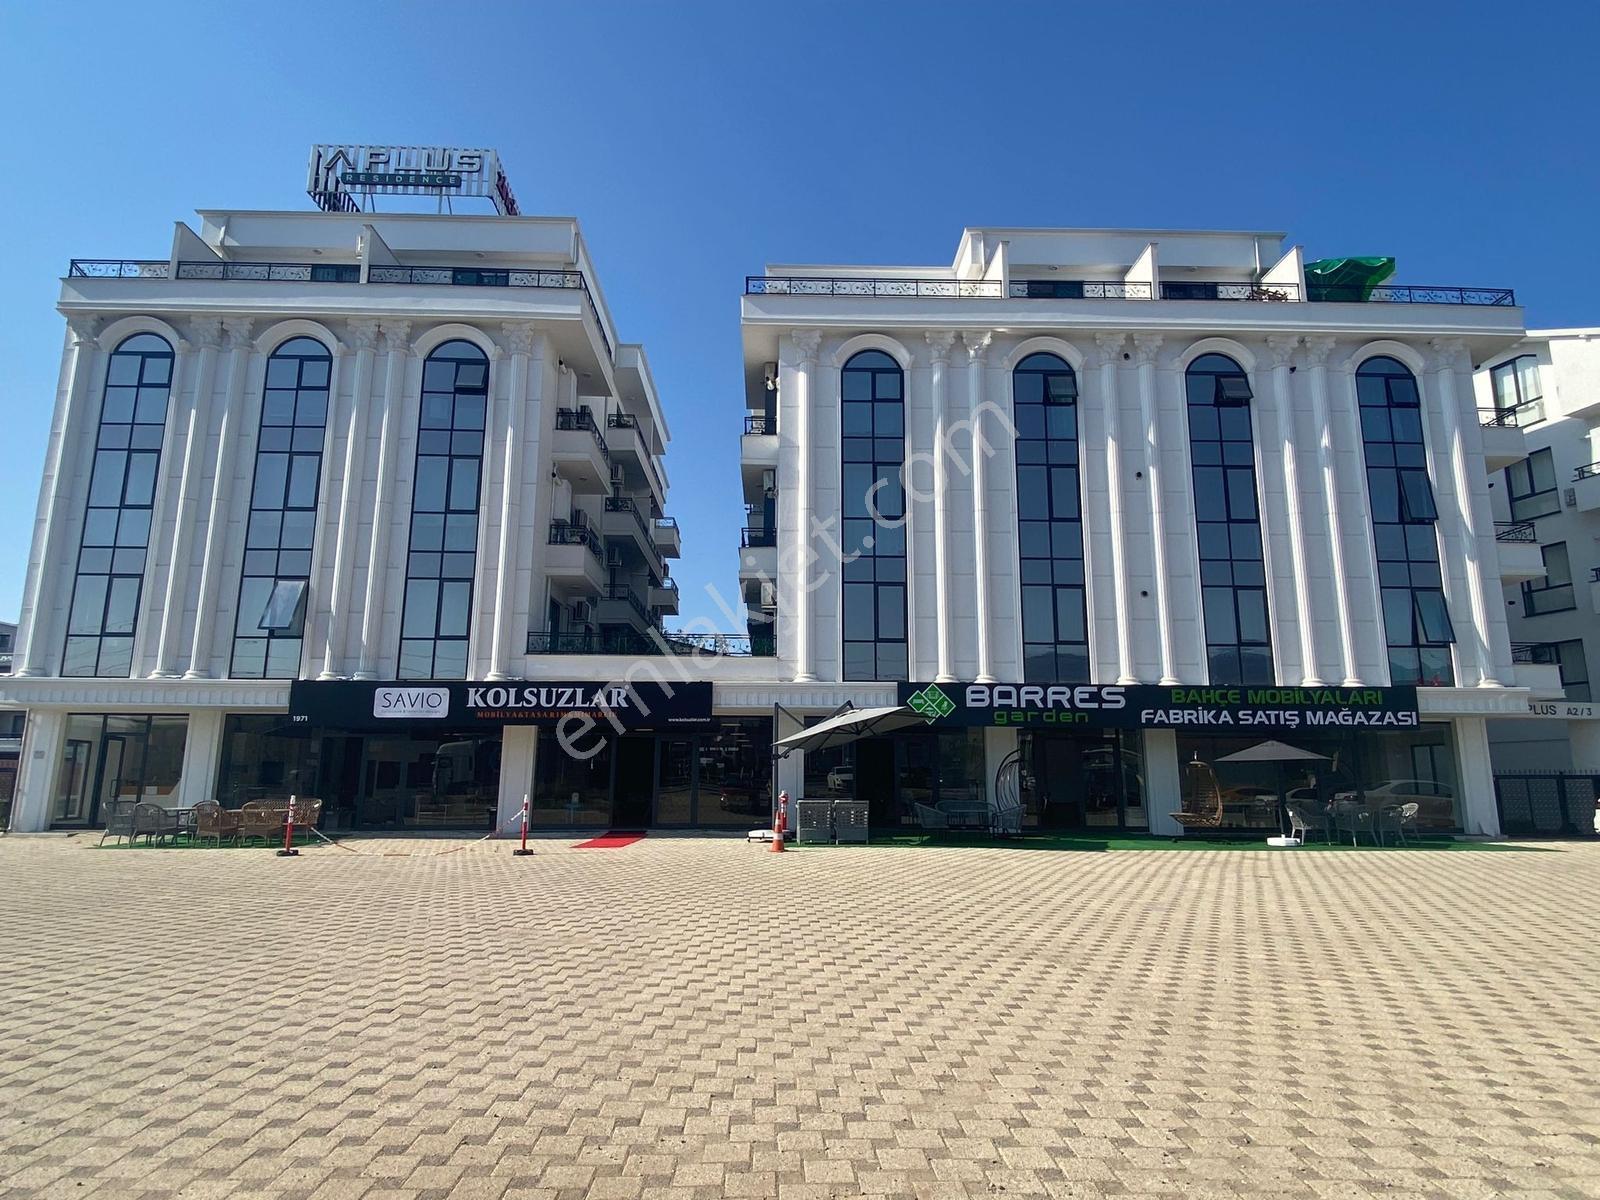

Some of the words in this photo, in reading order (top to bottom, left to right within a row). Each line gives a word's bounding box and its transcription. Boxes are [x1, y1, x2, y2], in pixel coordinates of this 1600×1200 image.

[345, 174, 458, 184] RESIDENCE
[381, 692, 442, 709] SAVIO
[466, 687, 630, 708] KOLSUZLAR
[965, 686, 1126, 709] BARRES
[1171, 689, 1241, 708] BAHÇE
[1248, 688, 1383, 705] MOBİLYALARI
[993, 709, 1089, 725] garden
[1141, 707, 1234, 725] FABRİKA
[1239, 710, 1300, 729] SATIŞ
[1306, 708, 1418, 726] MAĞAZASI
